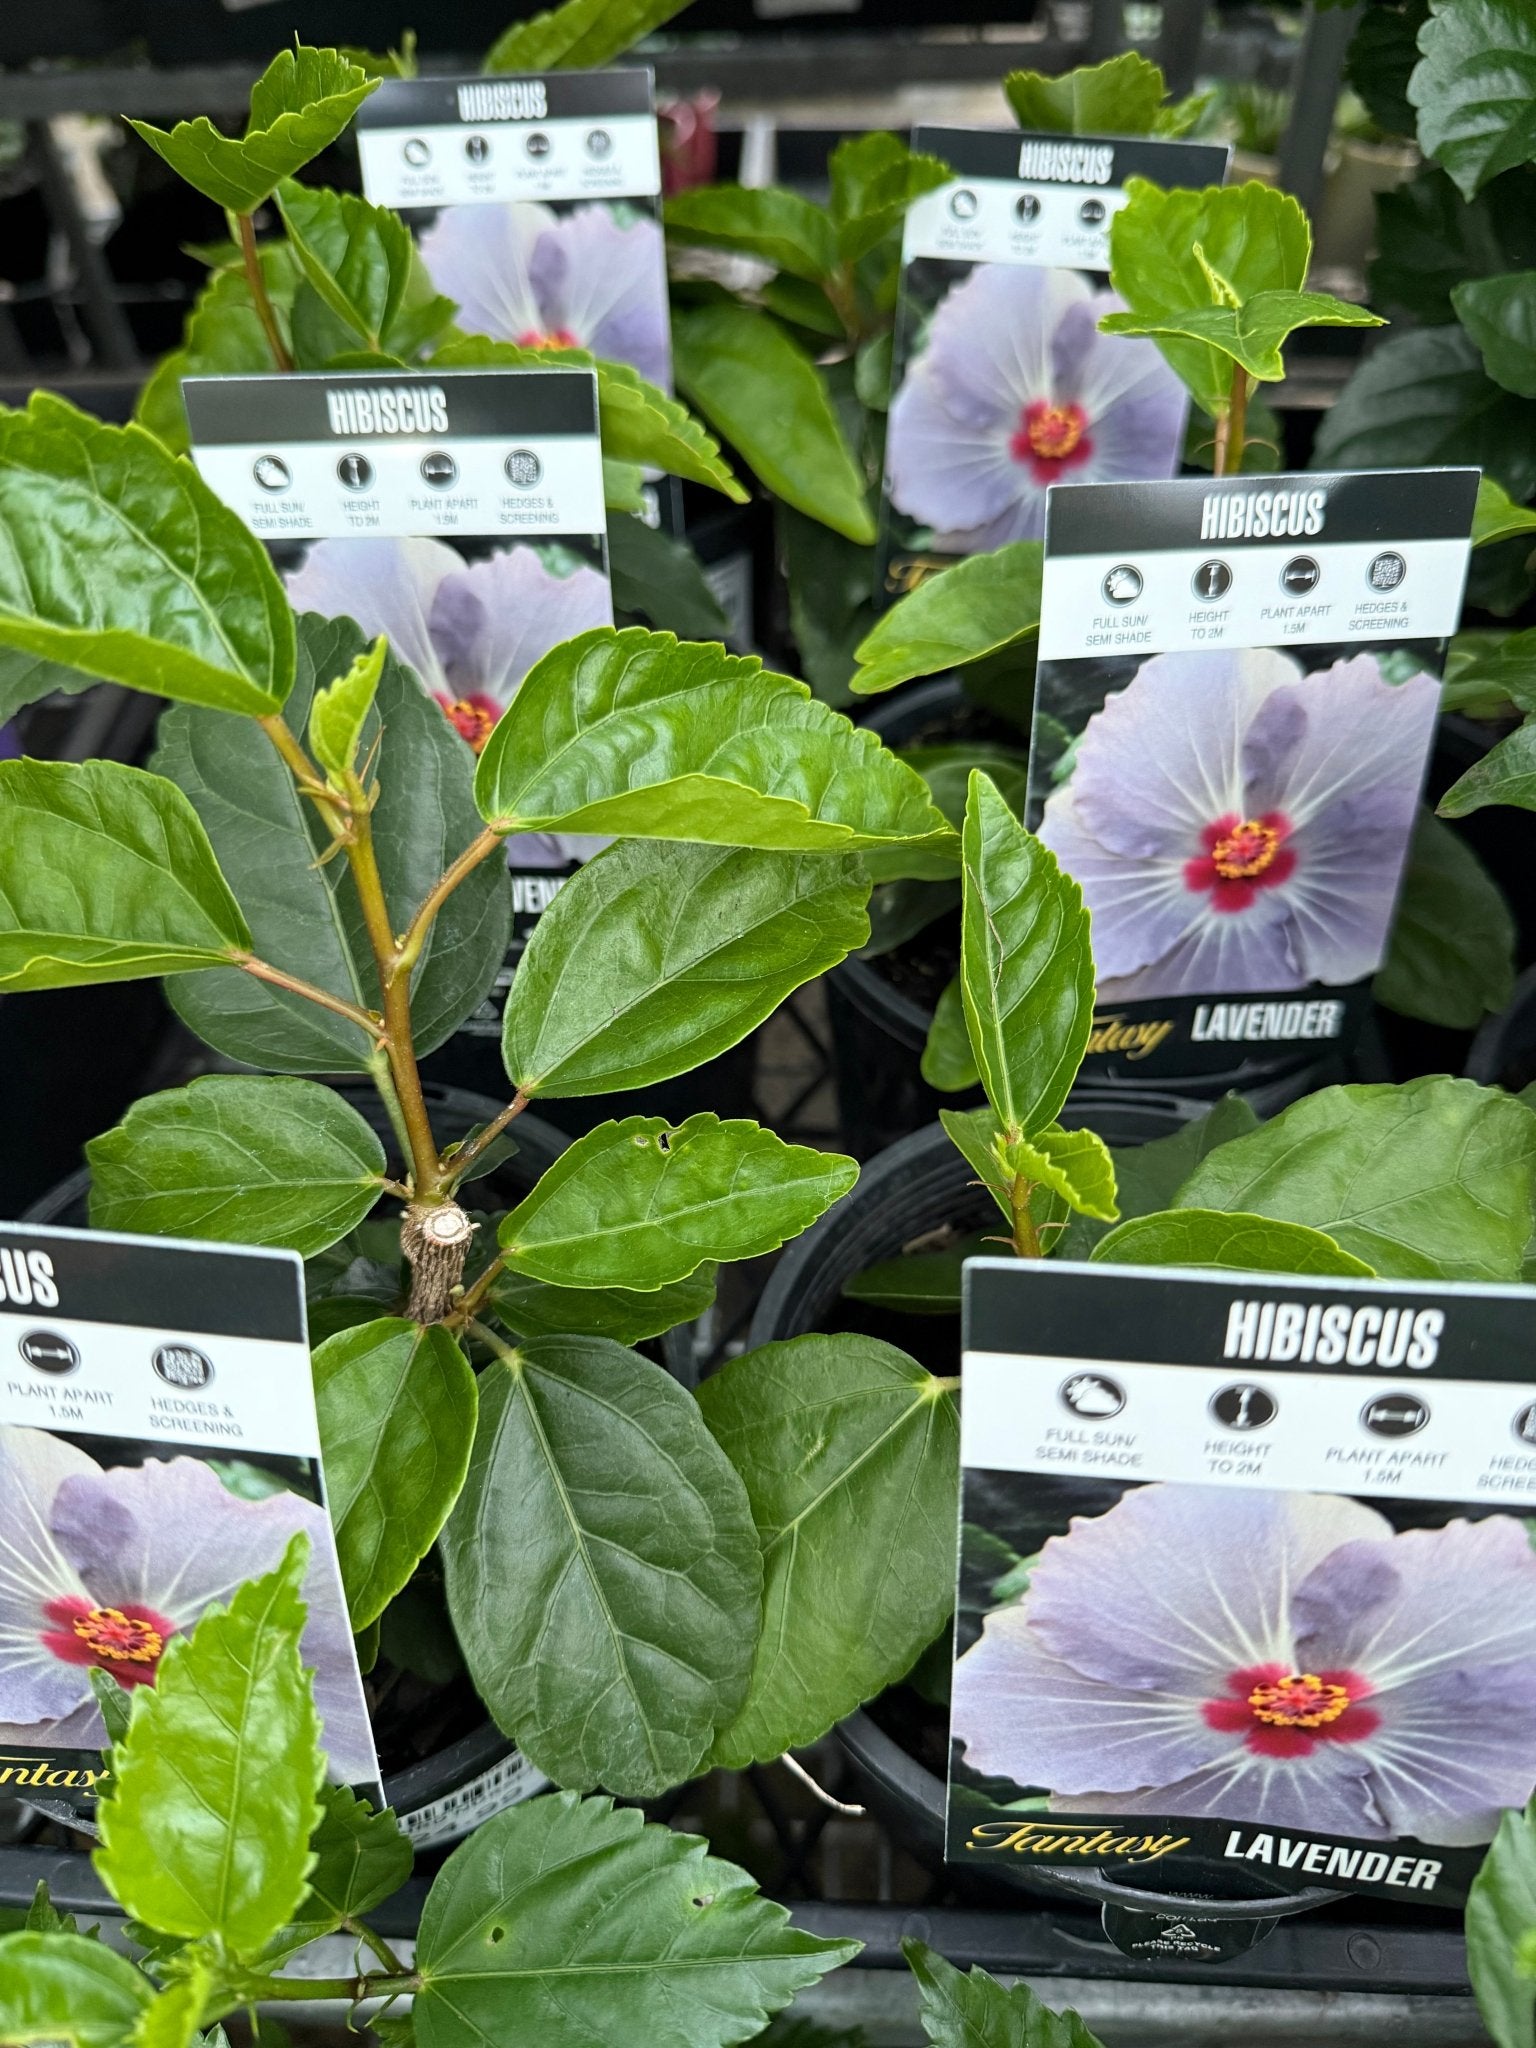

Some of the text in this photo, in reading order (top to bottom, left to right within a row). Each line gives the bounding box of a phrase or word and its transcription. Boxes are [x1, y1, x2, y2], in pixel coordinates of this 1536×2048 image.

[1019, 140, 1114, 184] HIBISCUS
[327, 385, 449, 434] HIBISCUS
[254, 502, 279, 514] FULL
[343, 500, 380, 512] HEIGHT
[410, 499, 479, 511] PLANT APART
[502, 498, 545, 509] HEDGES
[252, 516, 313, 529] SEMI SHADE
[349, 516, 380, 527] TO 2M
[500, 513, 560, 525] SCREENING
[1200, 490, 1328, 540] HIBISCUS
[1260, 605, 1332, 619] PLANT APART
[1354, 601, 1408, 614] HEDGES &
[1092, 615, 1149, 630] FULL SUN/
[1188, 610, 1230, 624] HEIGHT
[1349, 617, 1409, 631] SCREENING
[1191, 627, 1224, 640] TO 2M
[1282, 622, 1306, 635] 1.5M
[1085, 631, 1152, 647] SEMI SHADE
[1191, 1000, 1343, 1041] LAVENDER
[1223, 1299, 1445, 1370] HIBISCUS
[8, 1382, 114, 1406] PLANT APART
[49, 1404, 84, 1421] 1.5M
[151, 1397, 235, 1420] HEDGES &
[149, 1414, 244, 1438] SCREENING
[1045, 1428, 1137, 1447] FULL SUN/
[1035, 1446, 1143, 1468] SEMI SHADE
[1203, 1439, 1272, 1458] HEIGHT
[1208, 1457, 1263, 1476] TO 2M
[1325, 1447, 1449, 1469] PLANT APART
[1363, 1468, 1403, 1485] 1.5M
[965, 1820, 1190, 1864] Fantasy
[1224, 1830, 1443, 1891] LAVENDER
[1172, 1939, 1222, 1952] RECYCLE
